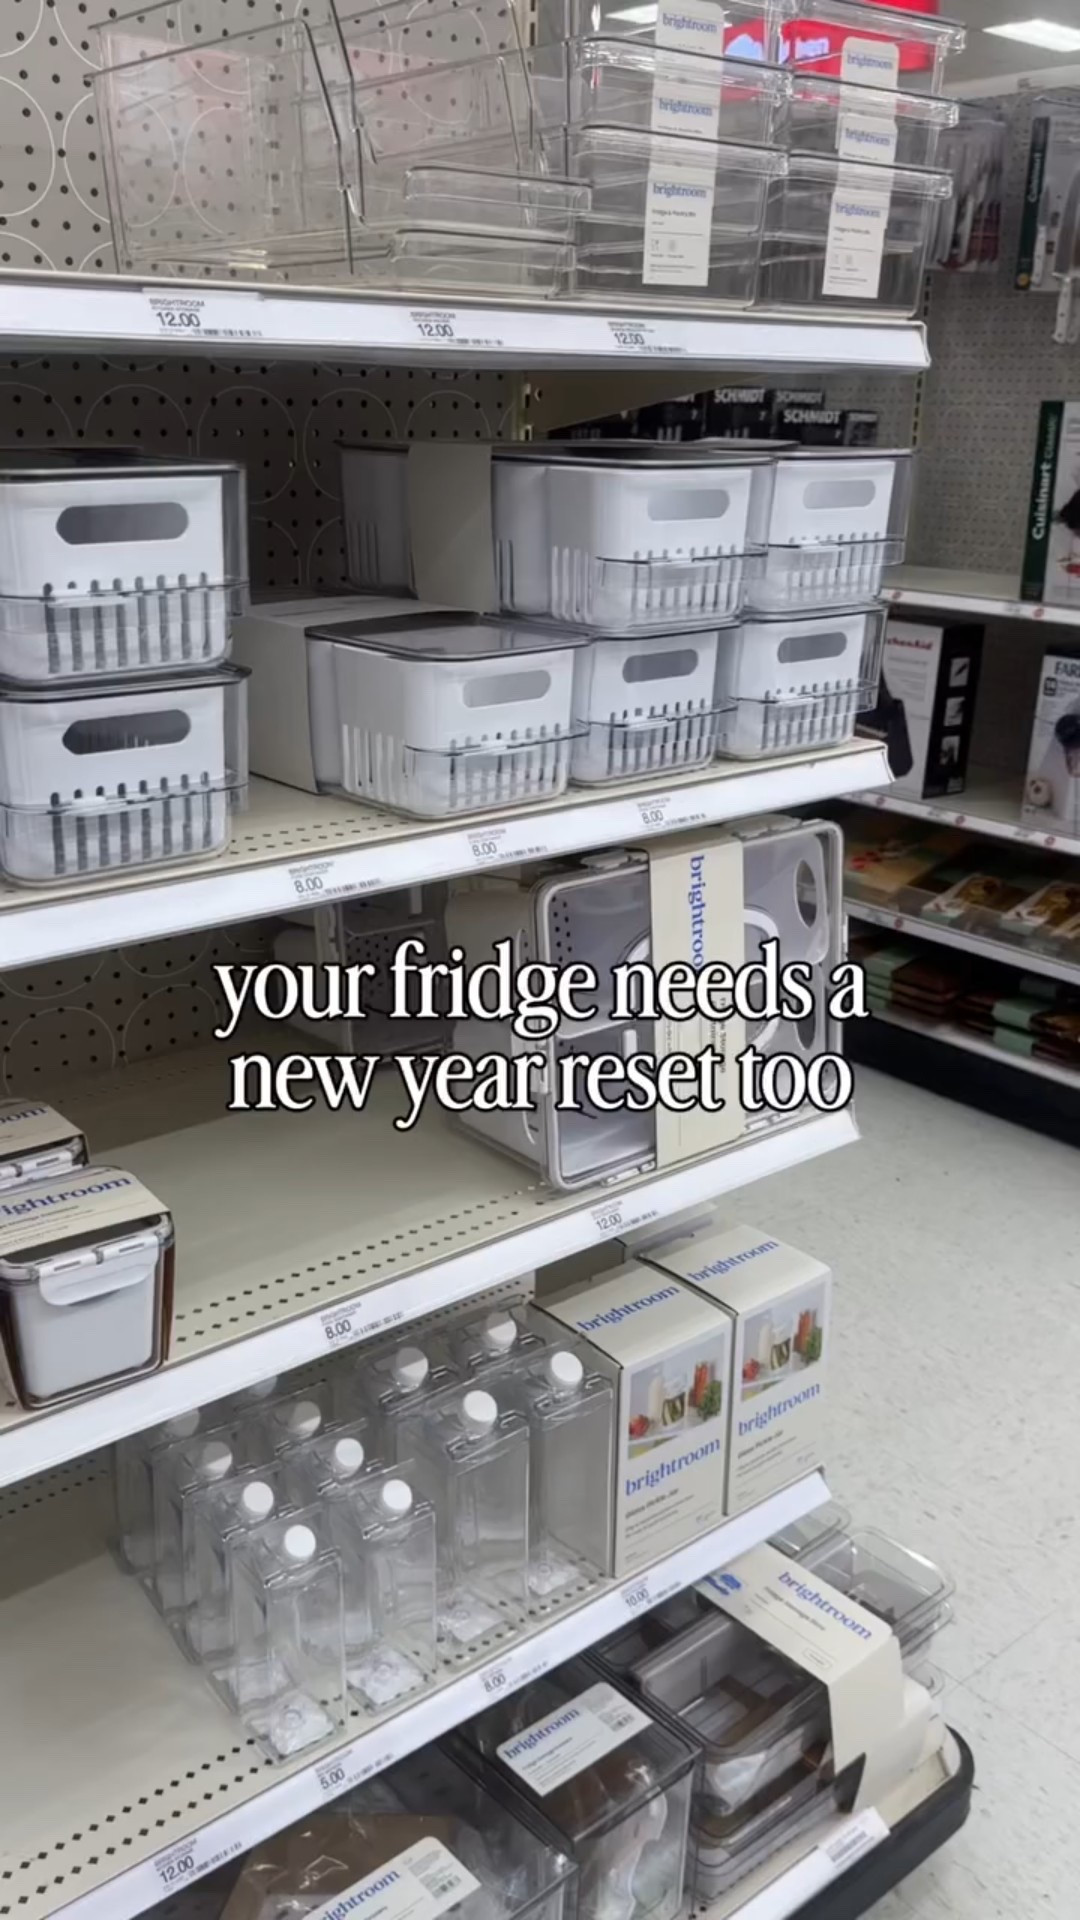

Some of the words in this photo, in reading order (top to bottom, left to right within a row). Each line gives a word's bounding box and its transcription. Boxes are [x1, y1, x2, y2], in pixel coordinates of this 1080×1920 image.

[662, 12, 718, 34] brightroom
[847, 53, 893, 71] brightroom
[658, 98, 714, 118] brightroom
[844, 127, 891, 146] brightroom
[653, 181, 707, 199] brightroom
[834, 201, 882, 219] brightroom
[155, 311, 201, 328] 12.00
[417, 322, 454, 337] 12.00
[613, 332, 645, 345] 12.00
[714, 387, 766, 403] SCHMIDT
[783, 408, 841, 425] SCHMIDT
[1031, 462, 1052, 540] Cuisinart
[641, 809, 664, 825] 8.00
[472, 841, 497, 857] 8.00
[293, 876, 323, 894] 8.00
[688, 855, 706, 971] brightroo
[595, 1212, 622, 1230] 12.00
[687, 1239, 780, 1282] brightroom
[576, 1285, 680, 1331] brightroom
[324, 1319, 351, 1339] 8.00
[738, 1383, 821, 1436] brightroom
[625, 1438, 721, 1496] brightroom
[625, 1587, 649, 1608] 10.00
[778, 1570, 873, 1641] brightroom
[484, 1673, 506, 1692] 8.00
[503, 1708, 580, 1759] brightroom
[320, 1767, 346, 1790] 5.00
[160, 1855, 194, 1884] 12.00
